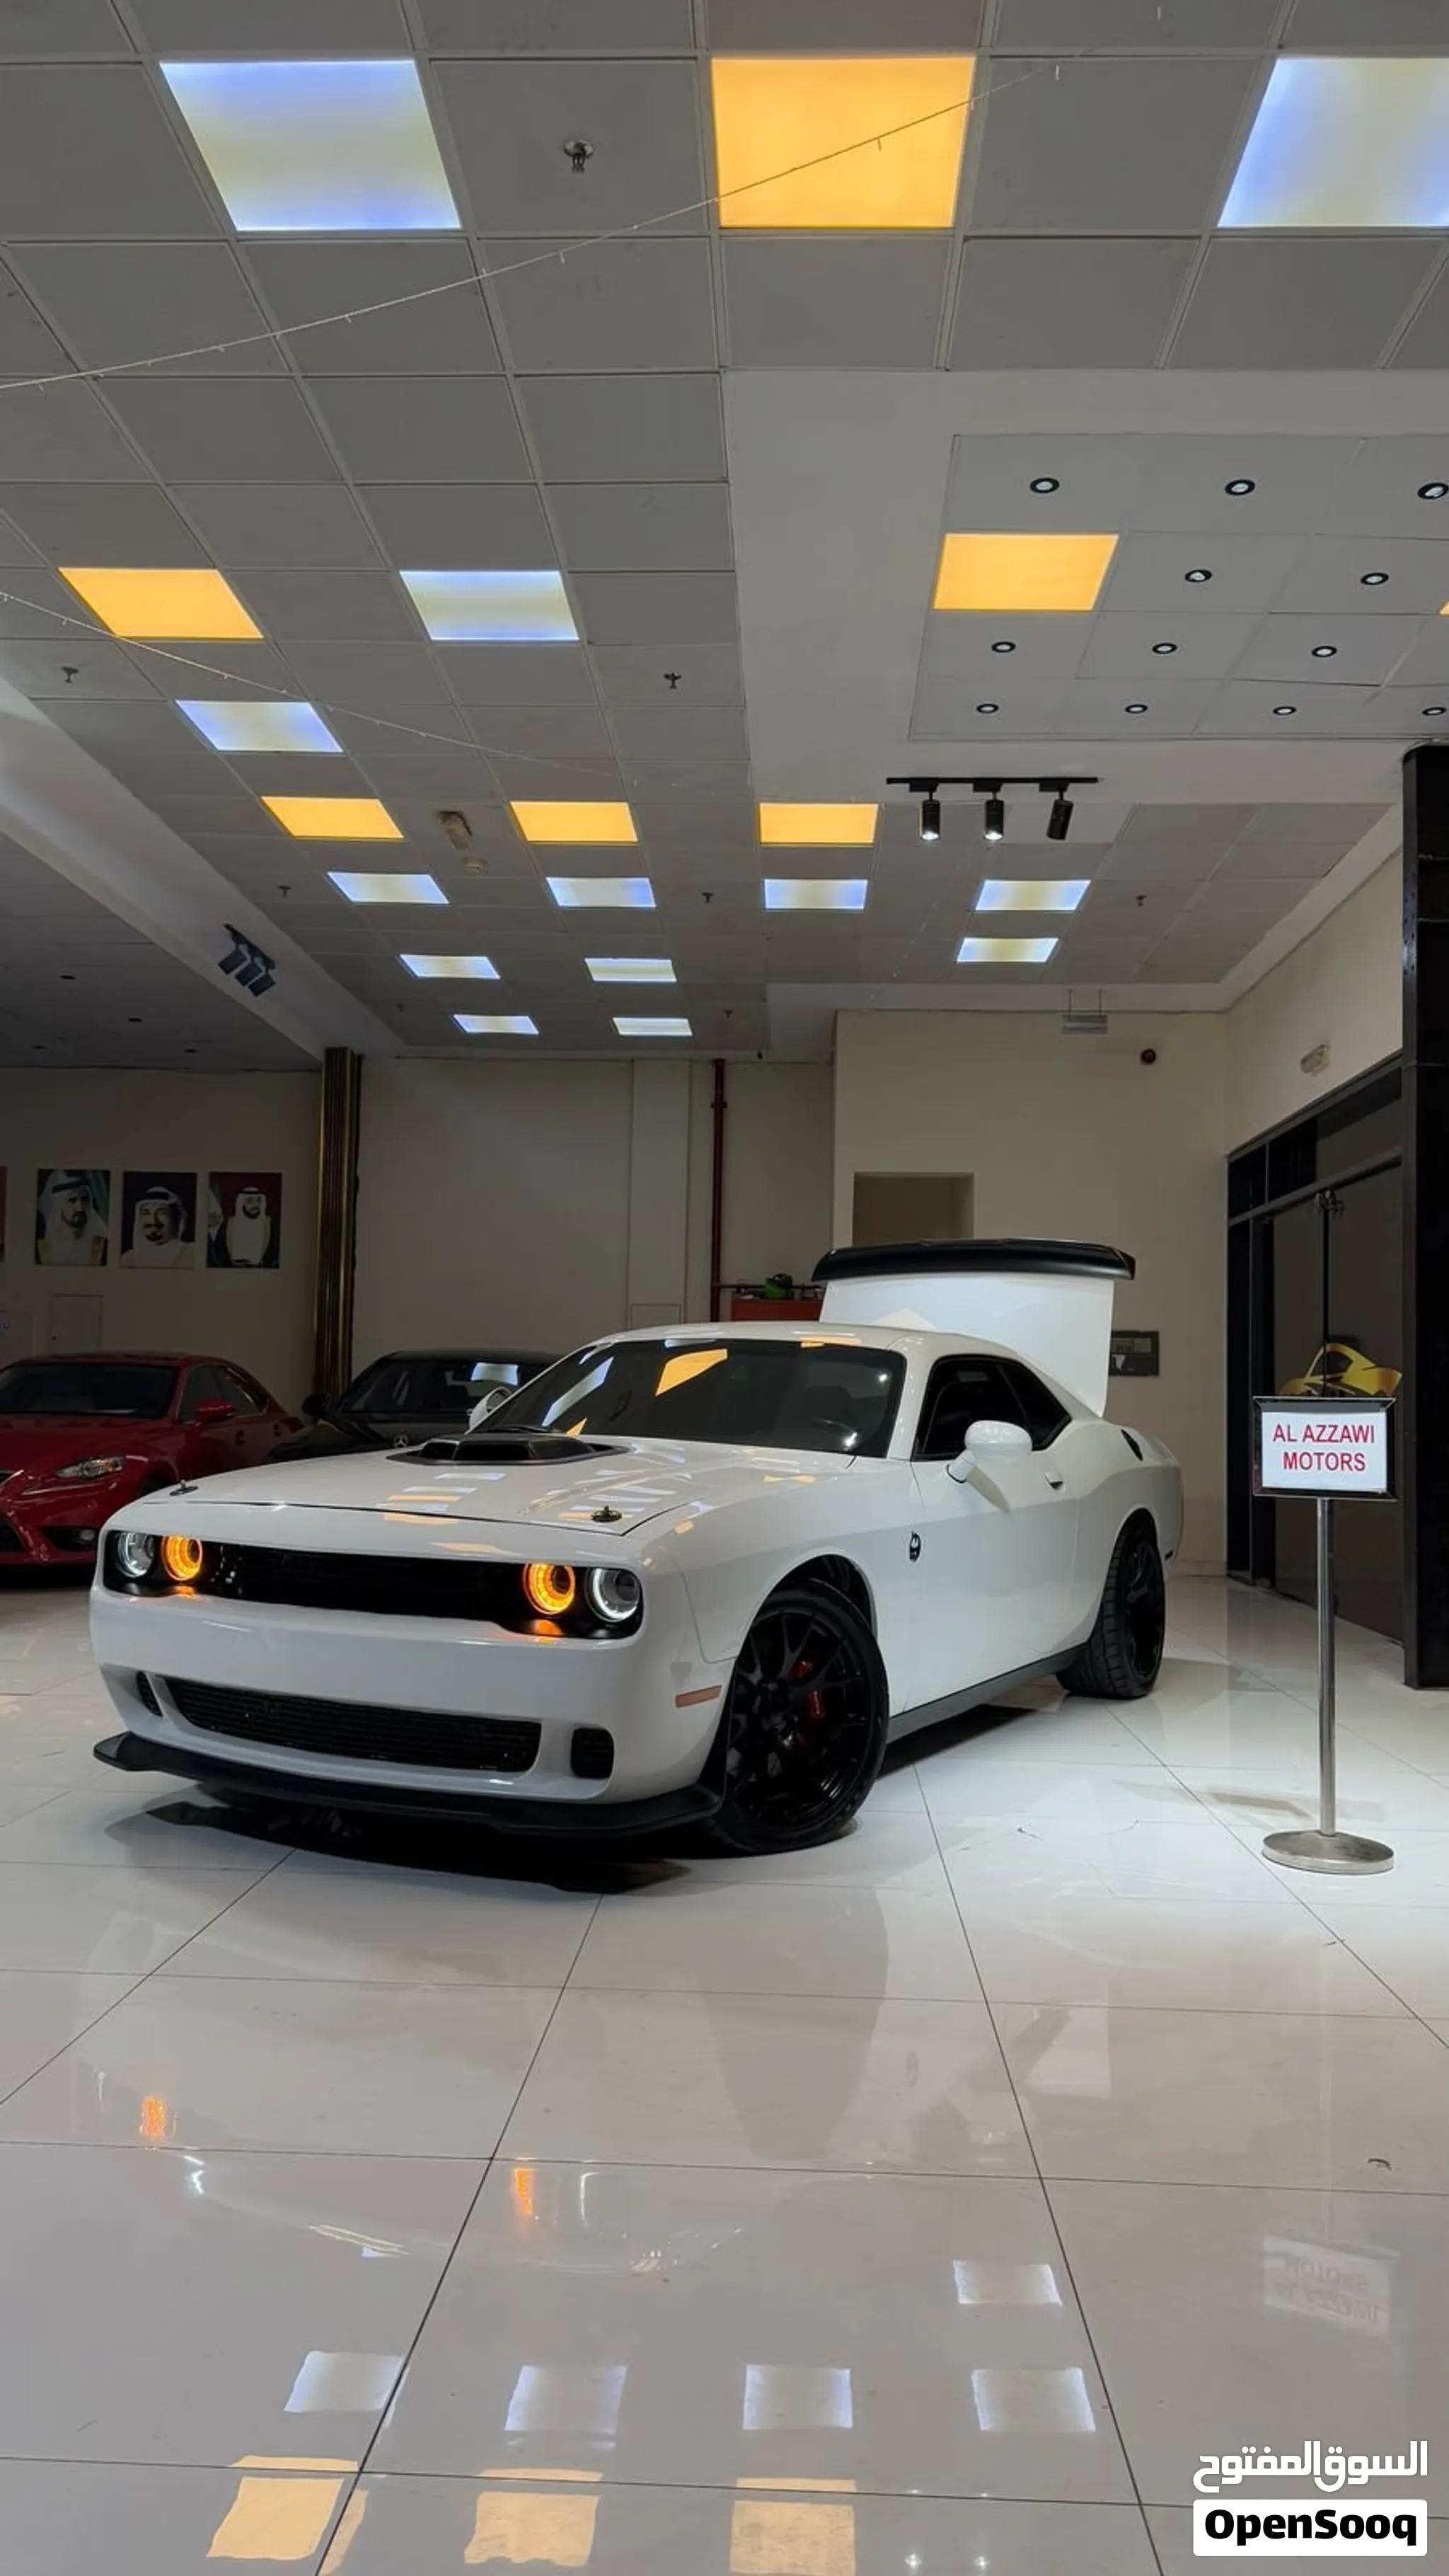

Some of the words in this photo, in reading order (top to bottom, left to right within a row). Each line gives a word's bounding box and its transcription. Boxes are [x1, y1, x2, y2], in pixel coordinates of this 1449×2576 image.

[1272, 1423, 1298, 1443] AL
[1302, 1423, 1375, 1443] AZZAWI
[1282, 1451, 1366, 1472] MOTORS
